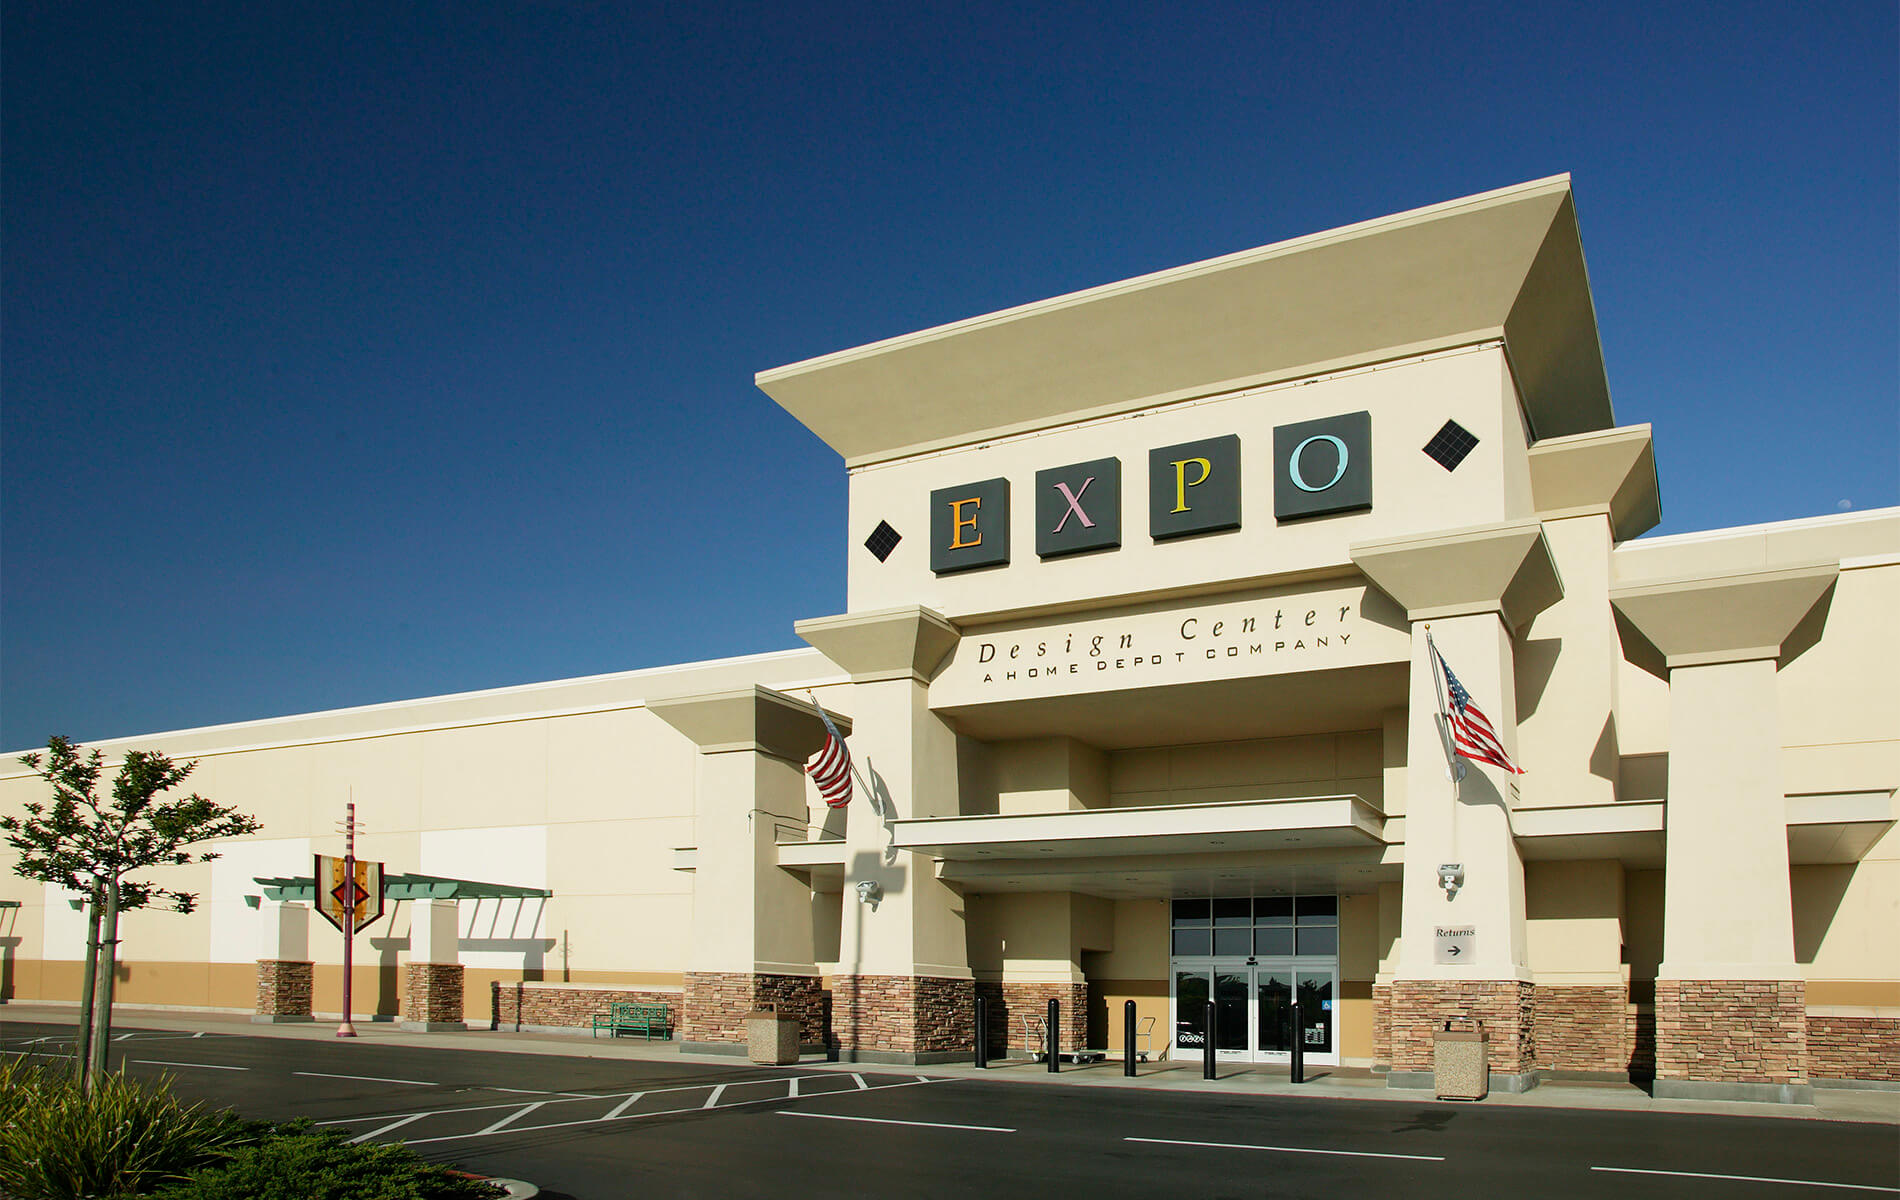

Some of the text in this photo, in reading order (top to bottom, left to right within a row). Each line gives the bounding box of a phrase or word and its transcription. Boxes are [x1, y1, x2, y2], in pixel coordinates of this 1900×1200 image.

[948, 434, 1349, 551] EXPO
[978, 605, 1350, 664] Design Center
[983, 634, 1351, 683] A HOME DEPOT COMPANY
[1436, 928, 1475, 938] Returns
